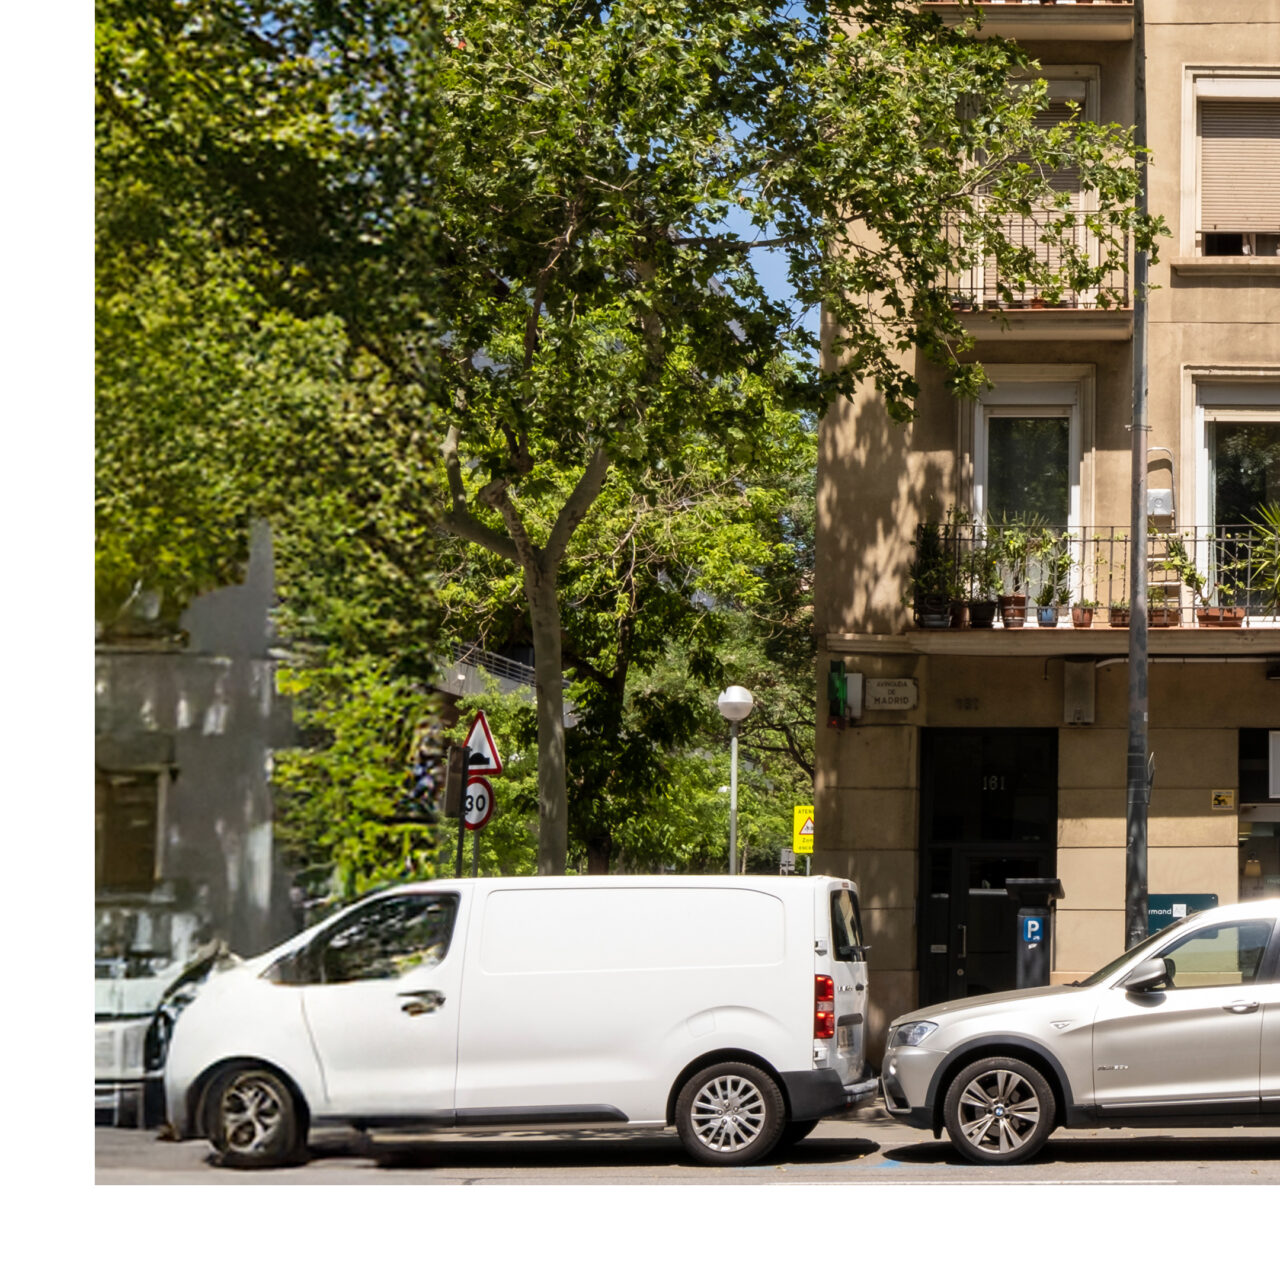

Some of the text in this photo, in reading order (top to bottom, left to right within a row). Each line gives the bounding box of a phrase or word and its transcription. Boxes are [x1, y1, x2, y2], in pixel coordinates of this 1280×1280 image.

[873, 696, 909, 704] MADRID
[465, 794, 486, 812] 30
[1027, 920, 1040, 939] P
